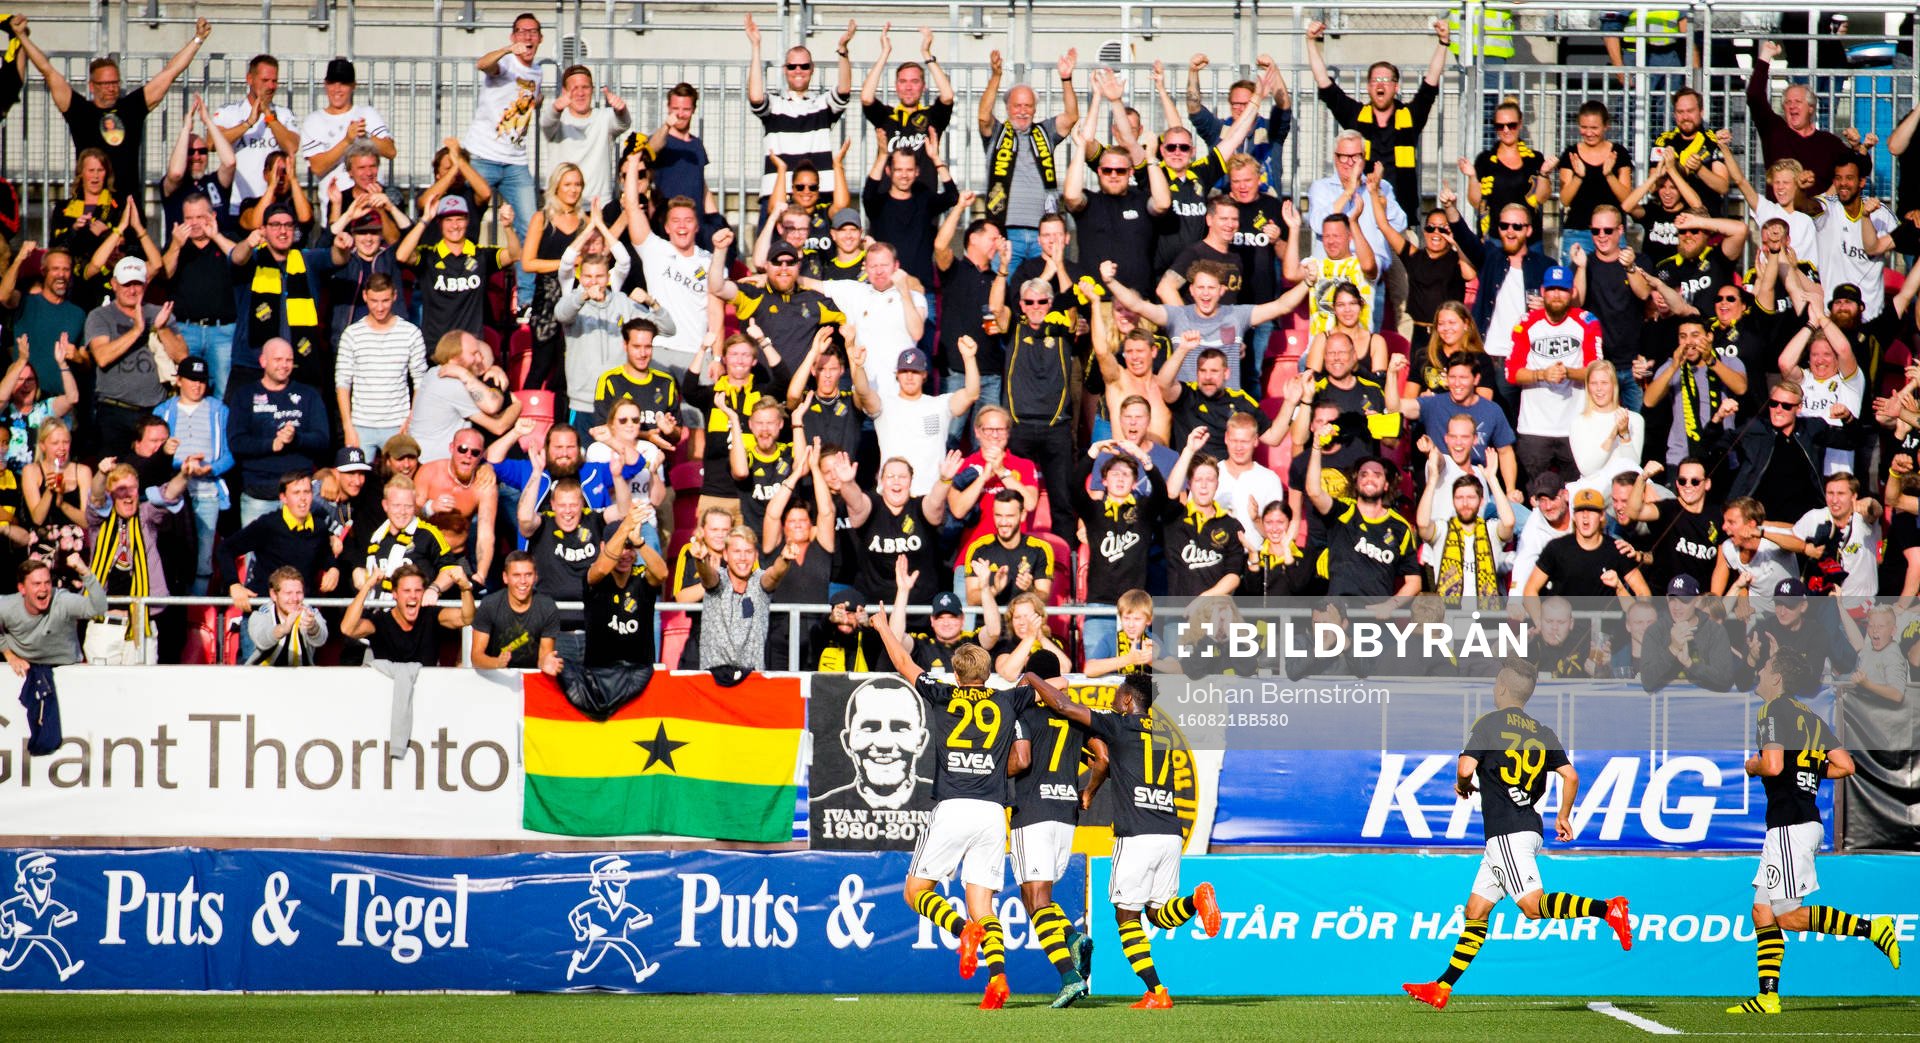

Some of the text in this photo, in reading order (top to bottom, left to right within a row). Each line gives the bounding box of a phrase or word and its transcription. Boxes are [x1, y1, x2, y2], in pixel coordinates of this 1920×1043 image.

[946, 698, 1002, 749] 29
[1048, 717, 1070, 773] 7
[1796, 714, 1827, 770] 24
[947, 751, 996, 770] SVEA
[1140, 731, 1172, 786] 17
[1500, 731, 1546, 792] 39
[823, 809, 869, 824] IVAN
[1039, 783, 1078, 798] SVEA
[1134, 786, 1175, 808] SVEA
[98, 869, 470, 965] Puts & Tegel
[674, 872, 799, 949] Puts
[826, 873, 875, 950] &
[1311, 905, 1398, 940] FÖR
[1409, 904, 1601, 941] HÅLBAR
